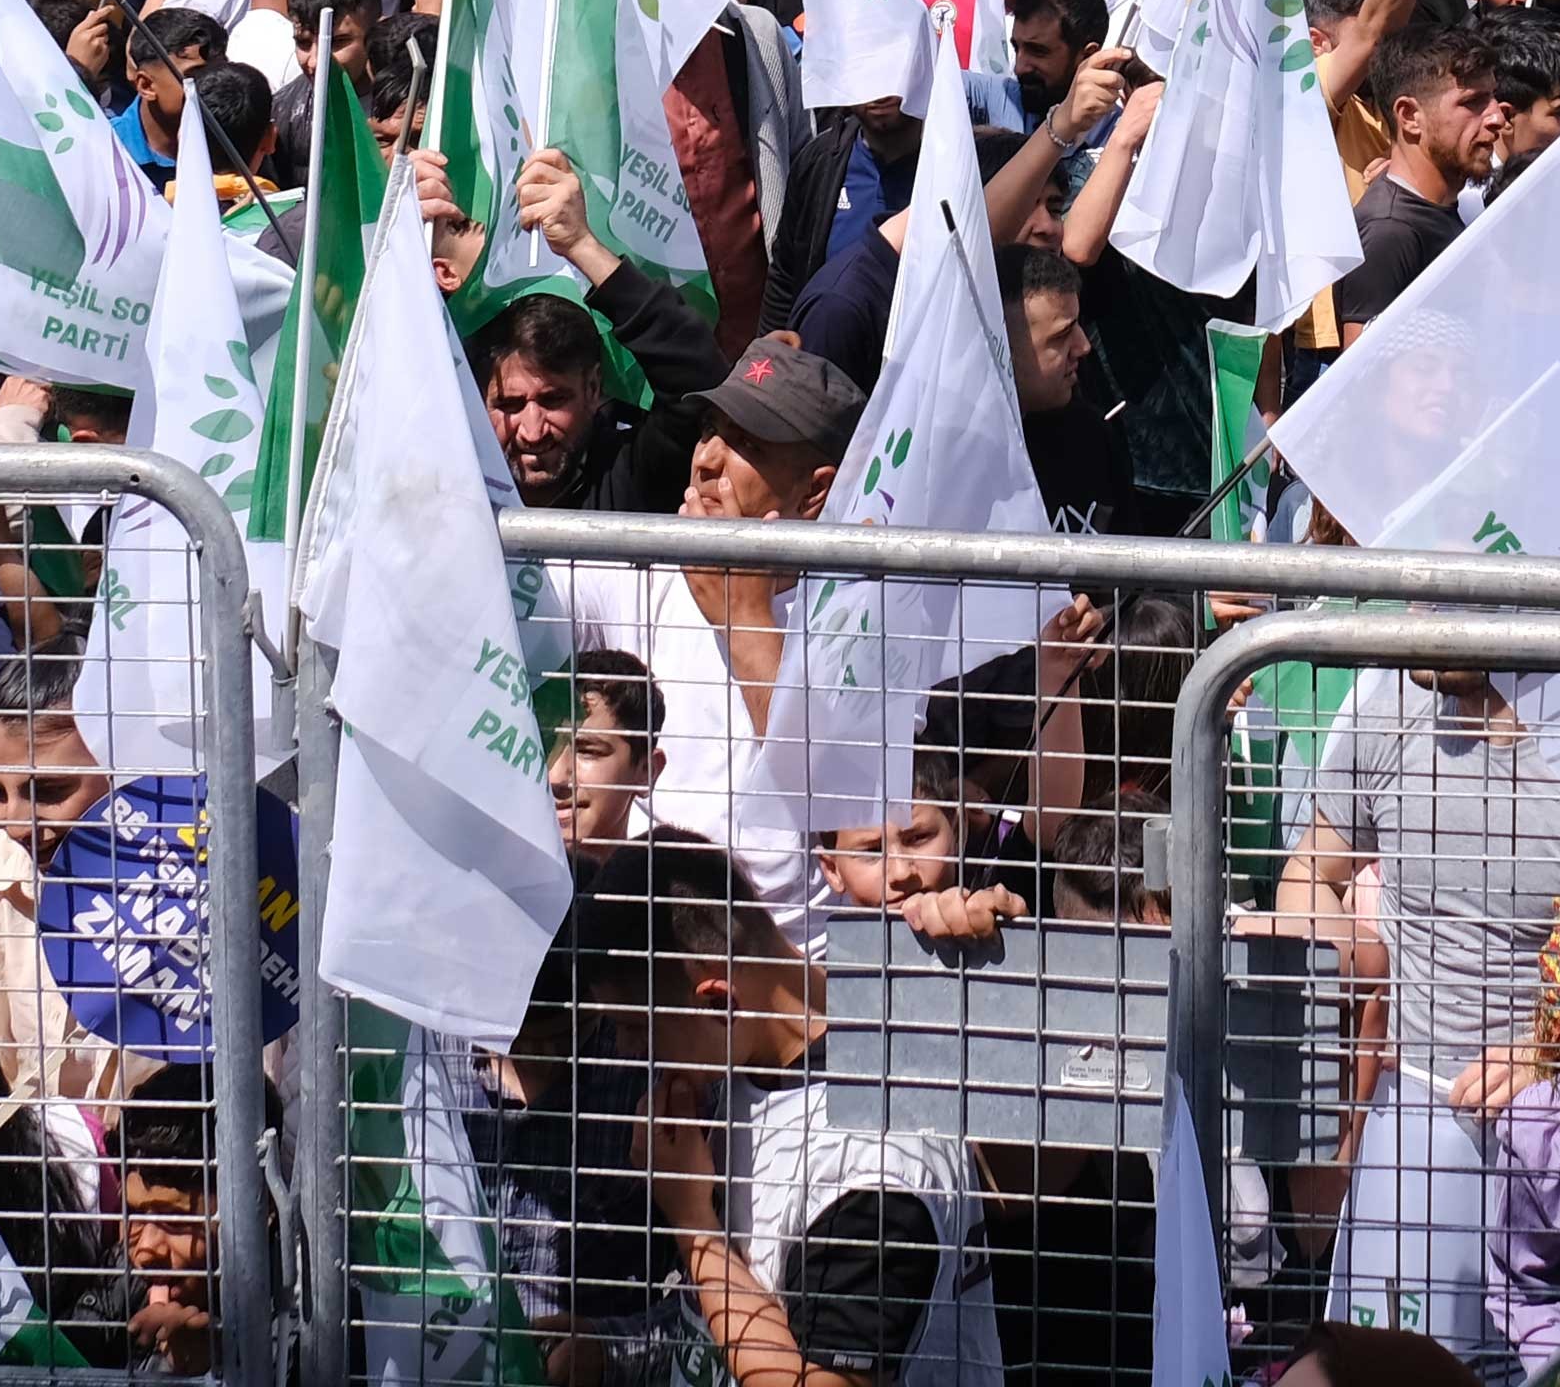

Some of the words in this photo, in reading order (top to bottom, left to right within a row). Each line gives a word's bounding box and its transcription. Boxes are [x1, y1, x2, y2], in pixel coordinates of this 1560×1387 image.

[620, 143, 669, 198] YEŞİL
[618, 189, 680, 245] PARTİ
[30, 267, 104, 314] YEŞİL
[111, 295, 151, 325] SO
[41, 315, 130, 360] PARTİ
[99, 567, 137, 632] SOL
